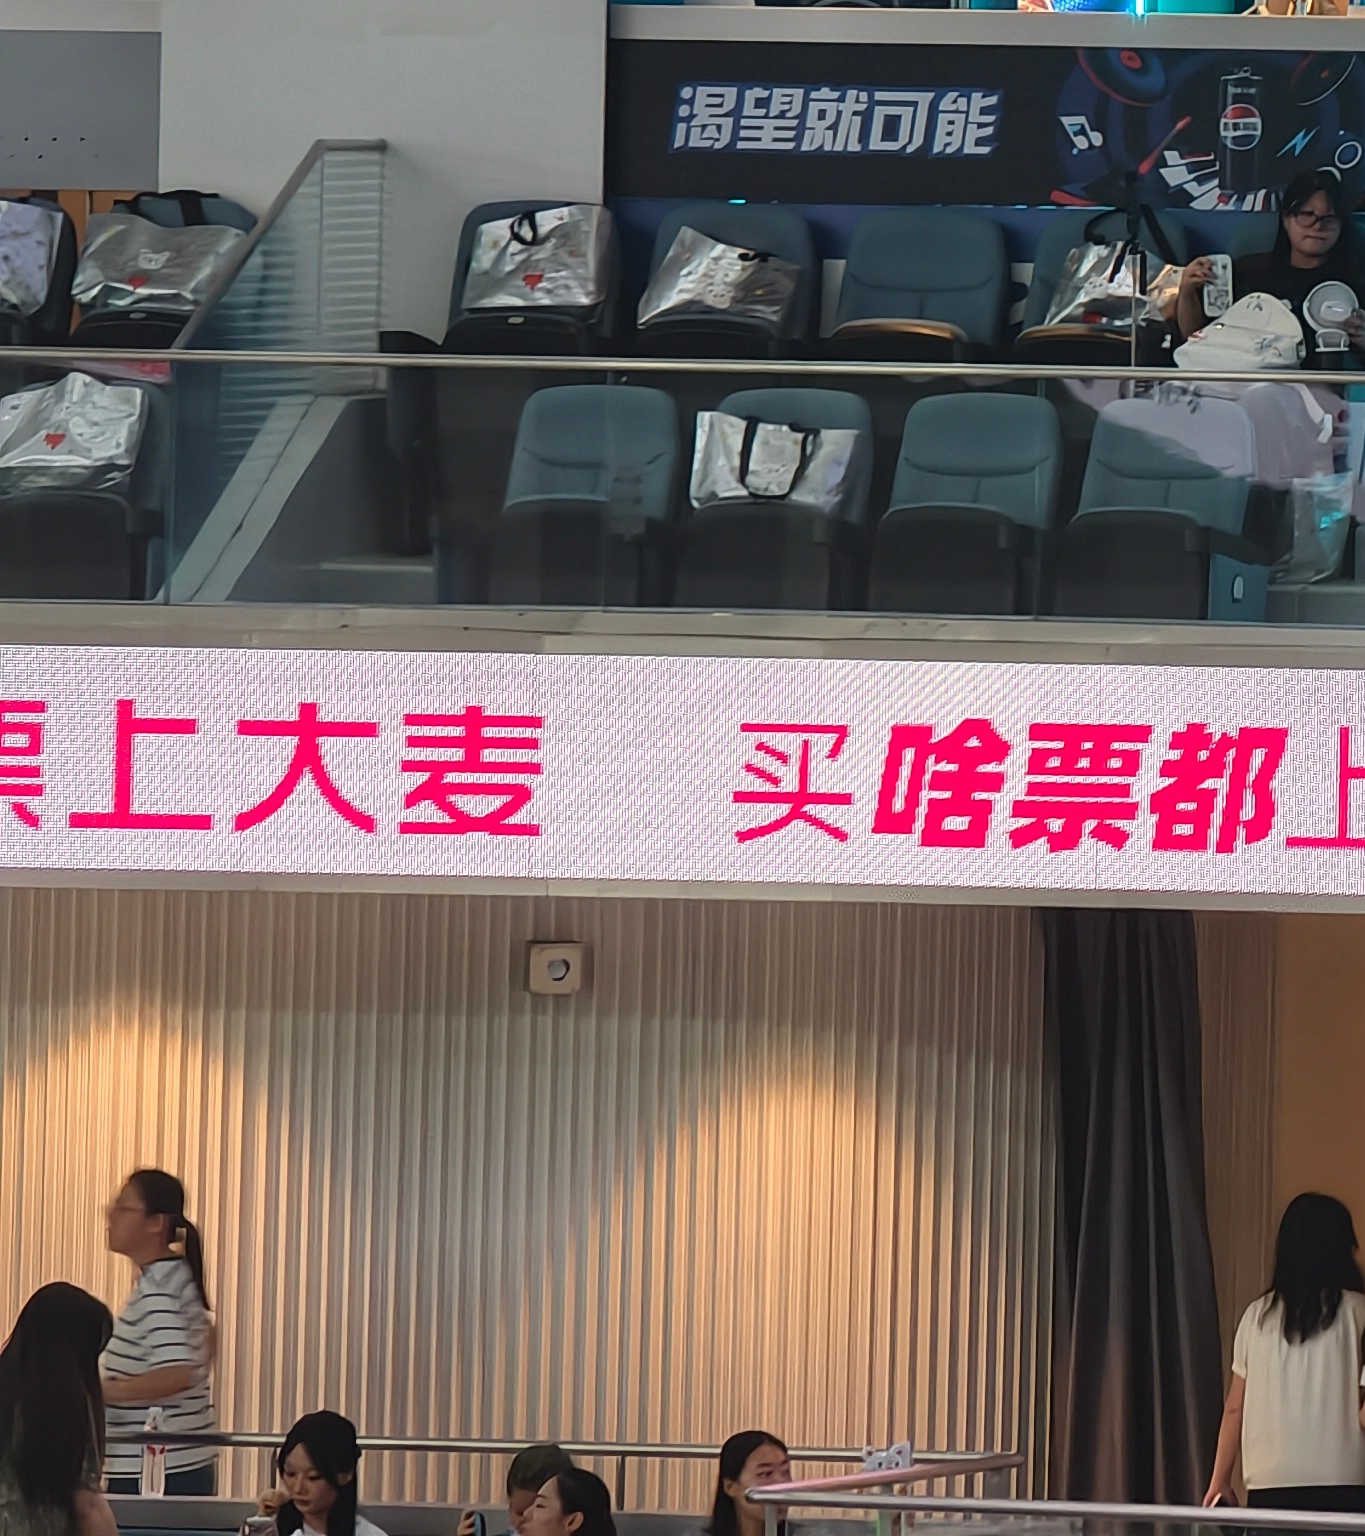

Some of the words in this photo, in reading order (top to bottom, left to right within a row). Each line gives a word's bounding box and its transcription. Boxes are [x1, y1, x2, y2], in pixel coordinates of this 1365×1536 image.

[673, 85, 1000, 154] 渴望就可能
